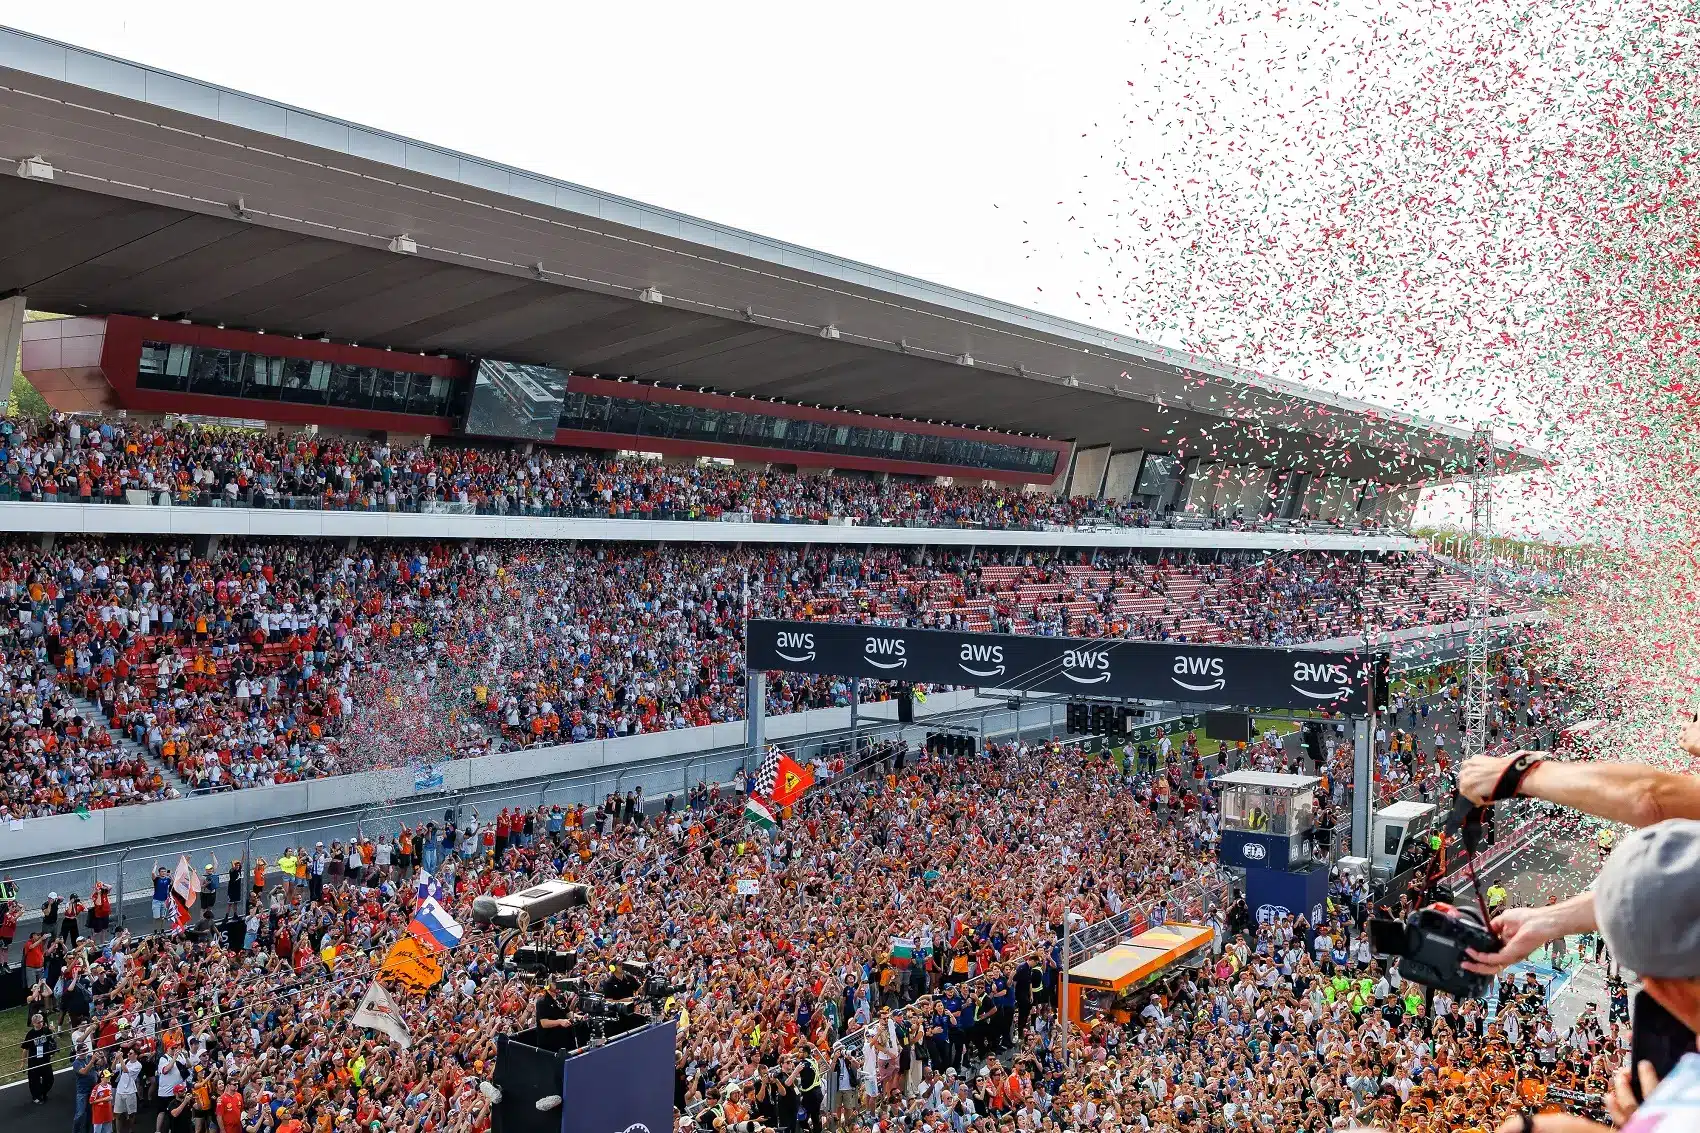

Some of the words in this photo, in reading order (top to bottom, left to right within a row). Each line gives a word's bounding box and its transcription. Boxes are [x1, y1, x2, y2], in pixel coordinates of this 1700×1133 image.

[776, 631, 815, 650] aws
[865, 637, 906, 656] aws
[960, 643, 1004, 663] aws
[1062, 649, 1110, 670] aws
[1173, 655, 1224, 677] aws
[1293, 661, 1348, 684] aws
